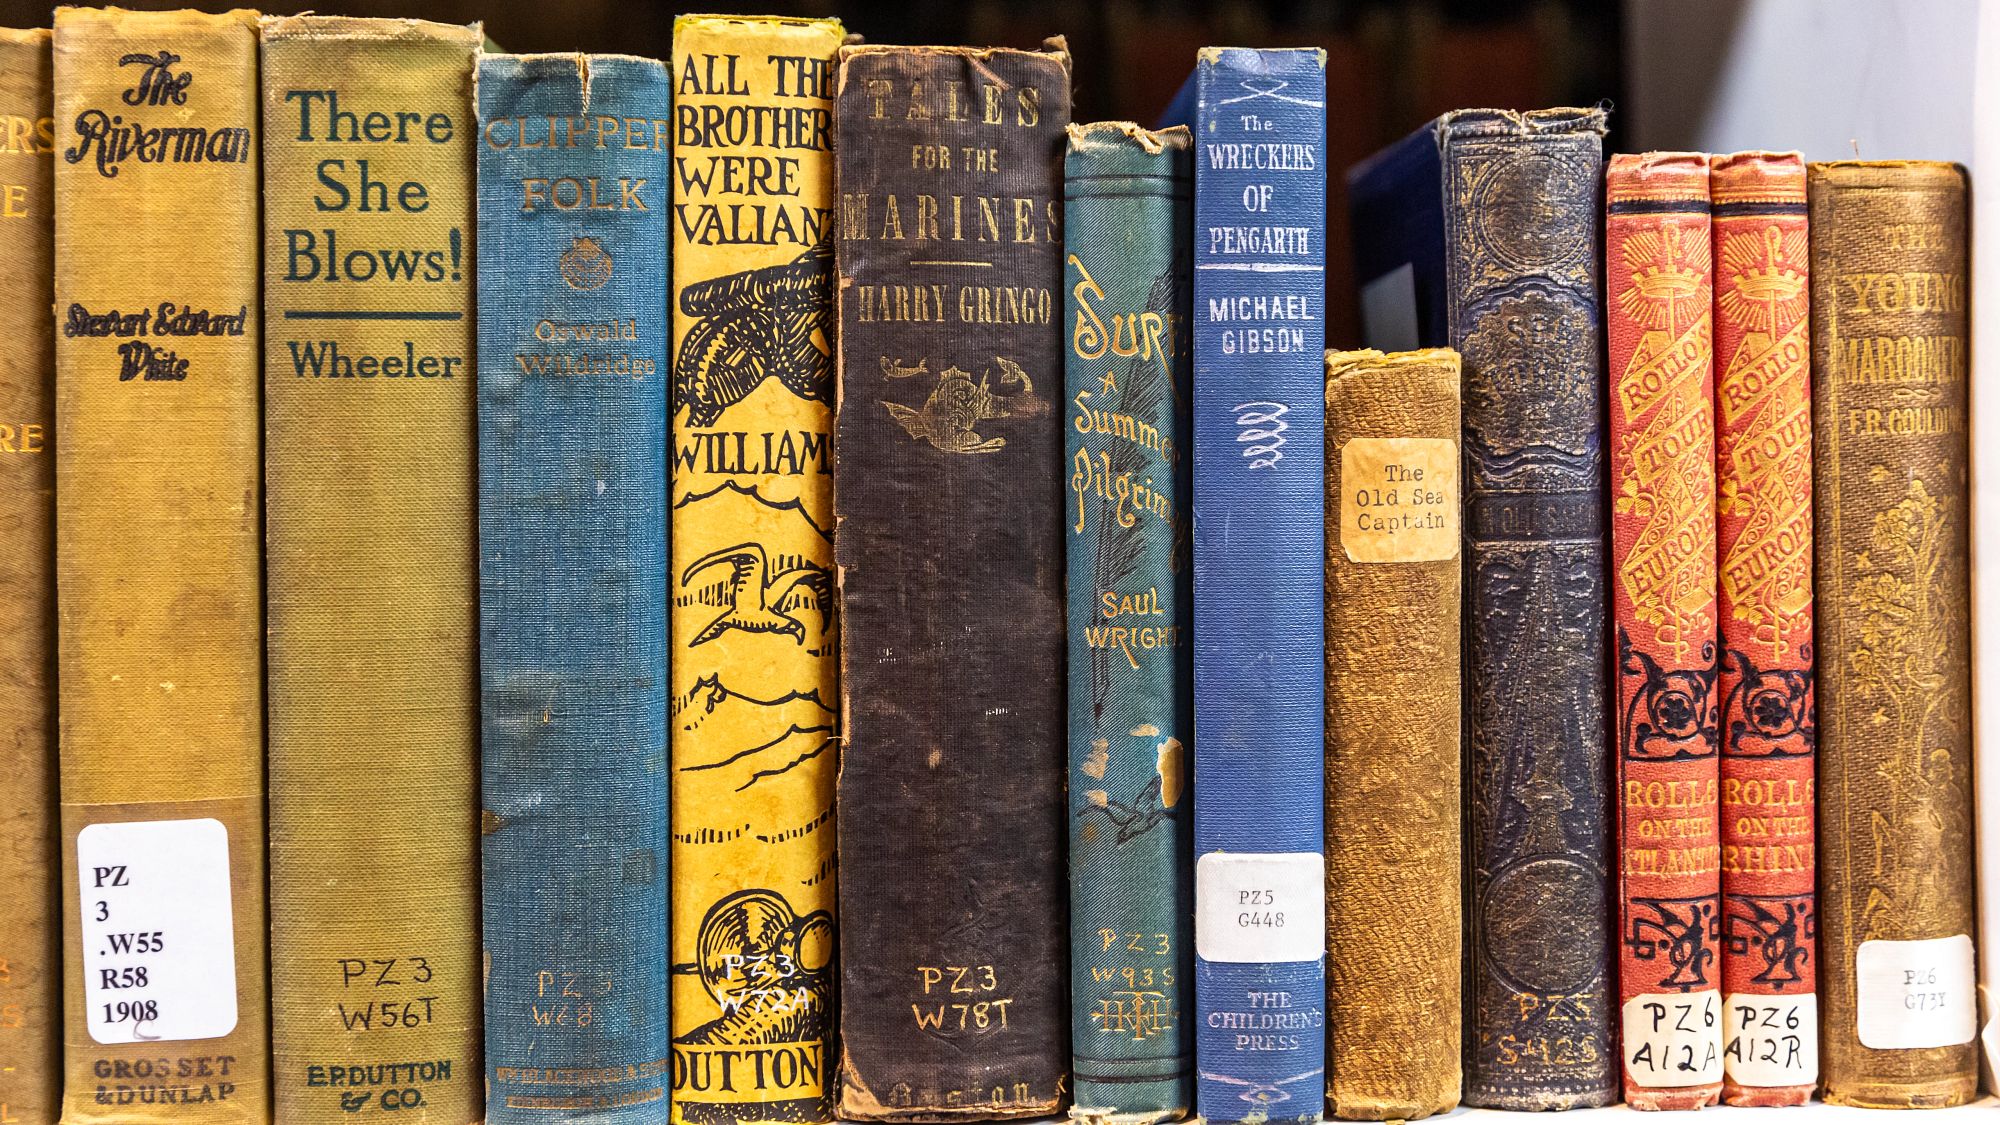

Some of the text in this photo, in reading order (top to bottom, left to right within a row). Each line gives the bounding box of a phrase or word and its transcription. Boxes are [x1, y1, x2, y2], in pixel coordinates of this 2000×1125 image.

[119, 50, 193, 107] The
[679, 53, 832, 99] ALL THE
[867, 78, 1041, 127] TALES
[284, 90, 454, 143] There
[1241, 115, 1274, 131] The
[0, 115, 54, 153] RS
[64, 109, 250, 178] Riverman
[484, 115, 669, 152] CLIPPER
[912, 145, 999, 173] FOR THE
[1207, 143, 1315, 170] WRECKERS
[314, 159, 430, 213] She
[675, 156, 800, 198] WERE
[521, 177, 648, 212] FOLK
[1243, 185, 1274, 212] OF
[675, 203, 832, 246] VALIAN
[1209, 227, 1310, 254] PENGARTH
[283, 227, 463, 283] Blows!
[858, 285, 1051, 324] HARRY GRINGO
[1209, 296, 1315, 322] MICHAEL
[153, 302, 247, 337] Edward
[535, 319, 637, 341] Oswald
[1222, 329, 1304, 354] GIBSON
[118, 340, 190, 381] White
[286, 341, 463, 379] Wheeler
[515, 354, 655, 380] Wildridge
[1098, 370, 1118, 396] A
[674, 429, 834, 475] WILLIAM
[1641, 409, 1711, 474] TOUR
[1741, 409, 1810, 474] TOUR
[1385, 465, 1424, 482] The
[1356, 489, 1444, 507] Old Sea
[1358, 512, 1445, 534] Captain
[1103, 586, 1166, 618] SAUL
[1638, 817, 1712, 837] ON THE
[1736, 816, 1810, 836] ON THE
[1722, 845, 1813, 873] RHIN
[93, 866, 130, 888] PZ
[95, 900, 110, 922] 3
[1239, 890, 1274, 905] PZ5
[1239, 912, 1285, 928] G448
[99, 931, 164, 956] .W55
[100, 966, 149, 990] R58
[102, 999, 159, 1024] 1908
[1248, 991, 1292, 1008] THE
[1207, 1007, 1322, 1030] CHILDREN'S
[1236, 1034, 1300, 1051] PRESS
[94, 1055, 236, 1079] GROSSET
[674, 1044, 822, 1093] DUTTON
[341, 1088, 428, 1113] & CO.
